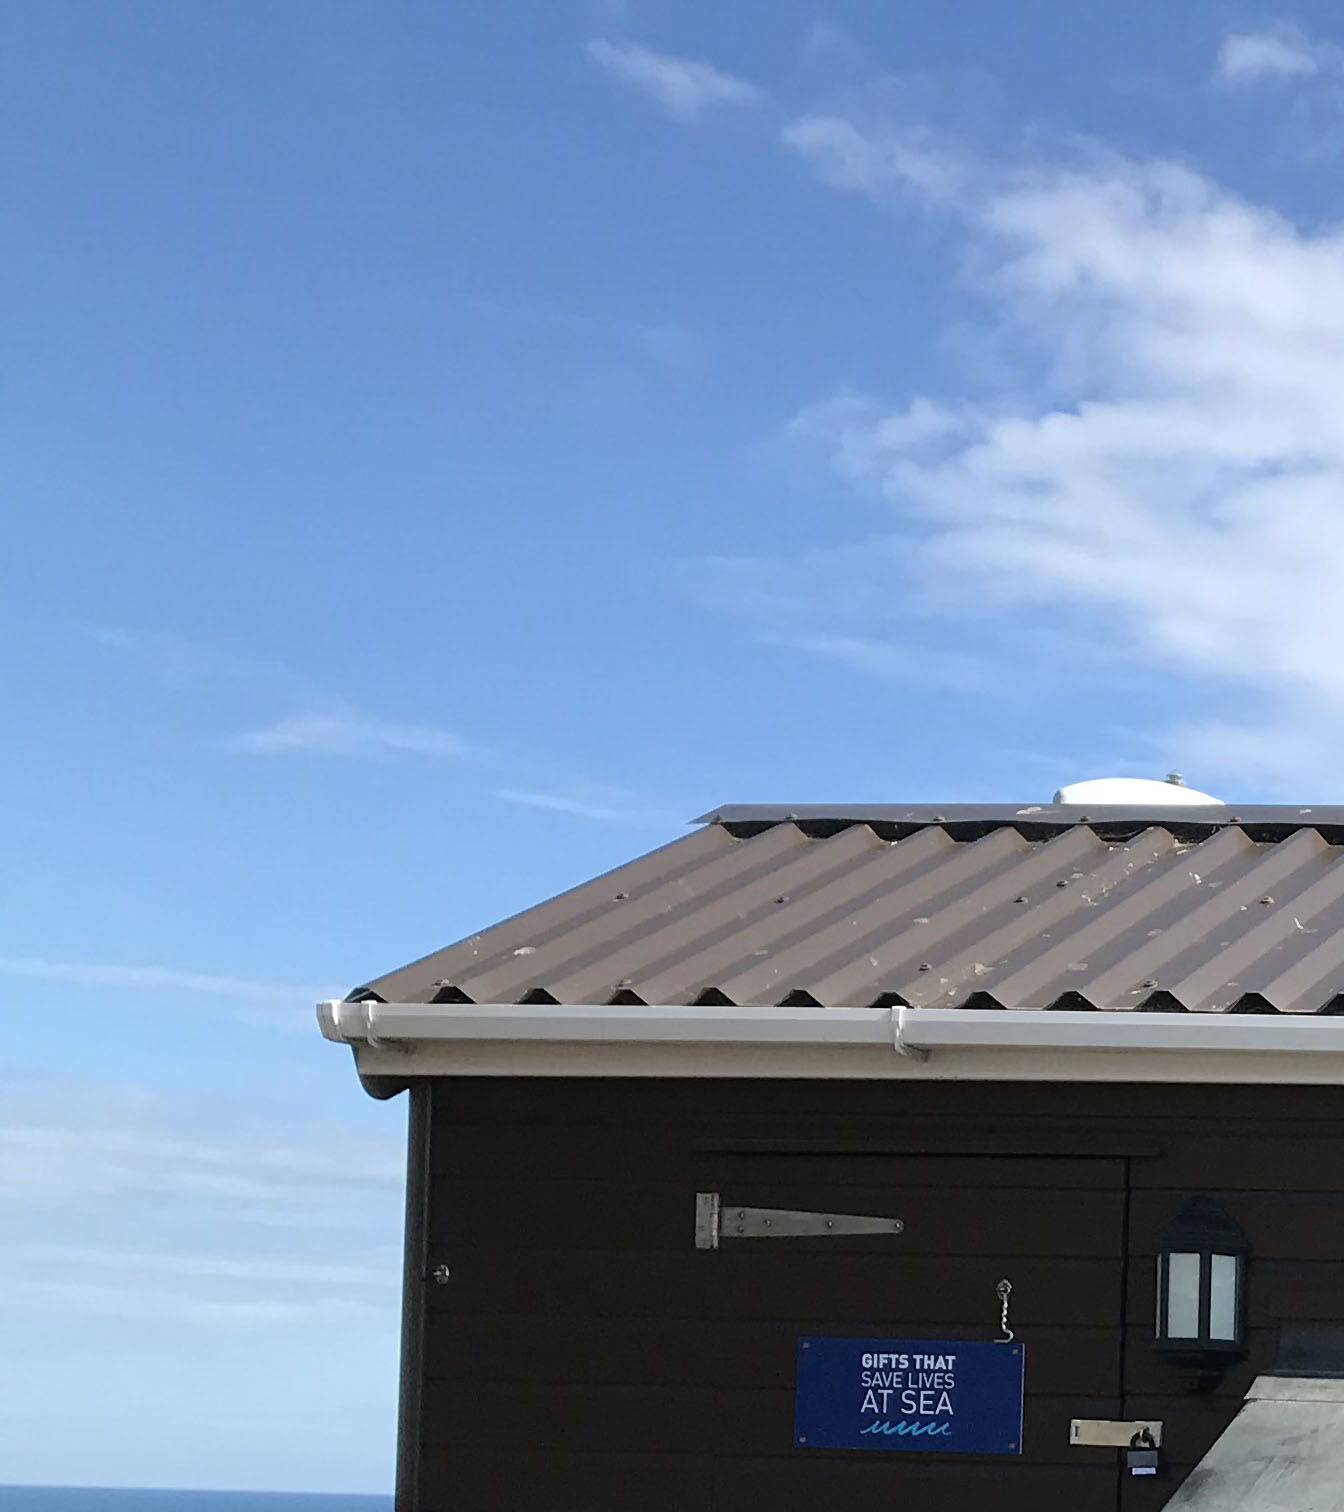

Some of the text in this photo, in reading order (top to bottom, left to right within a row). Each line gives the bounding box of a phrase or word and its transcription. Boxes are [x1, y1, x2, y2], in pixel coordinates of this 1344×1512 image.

[861, 1353, 956, 1370] GIFTS THAT
[860, 1371, 955, 1389] SAVE LIVES
[860, 1389, 954, 1415] AT SEA
